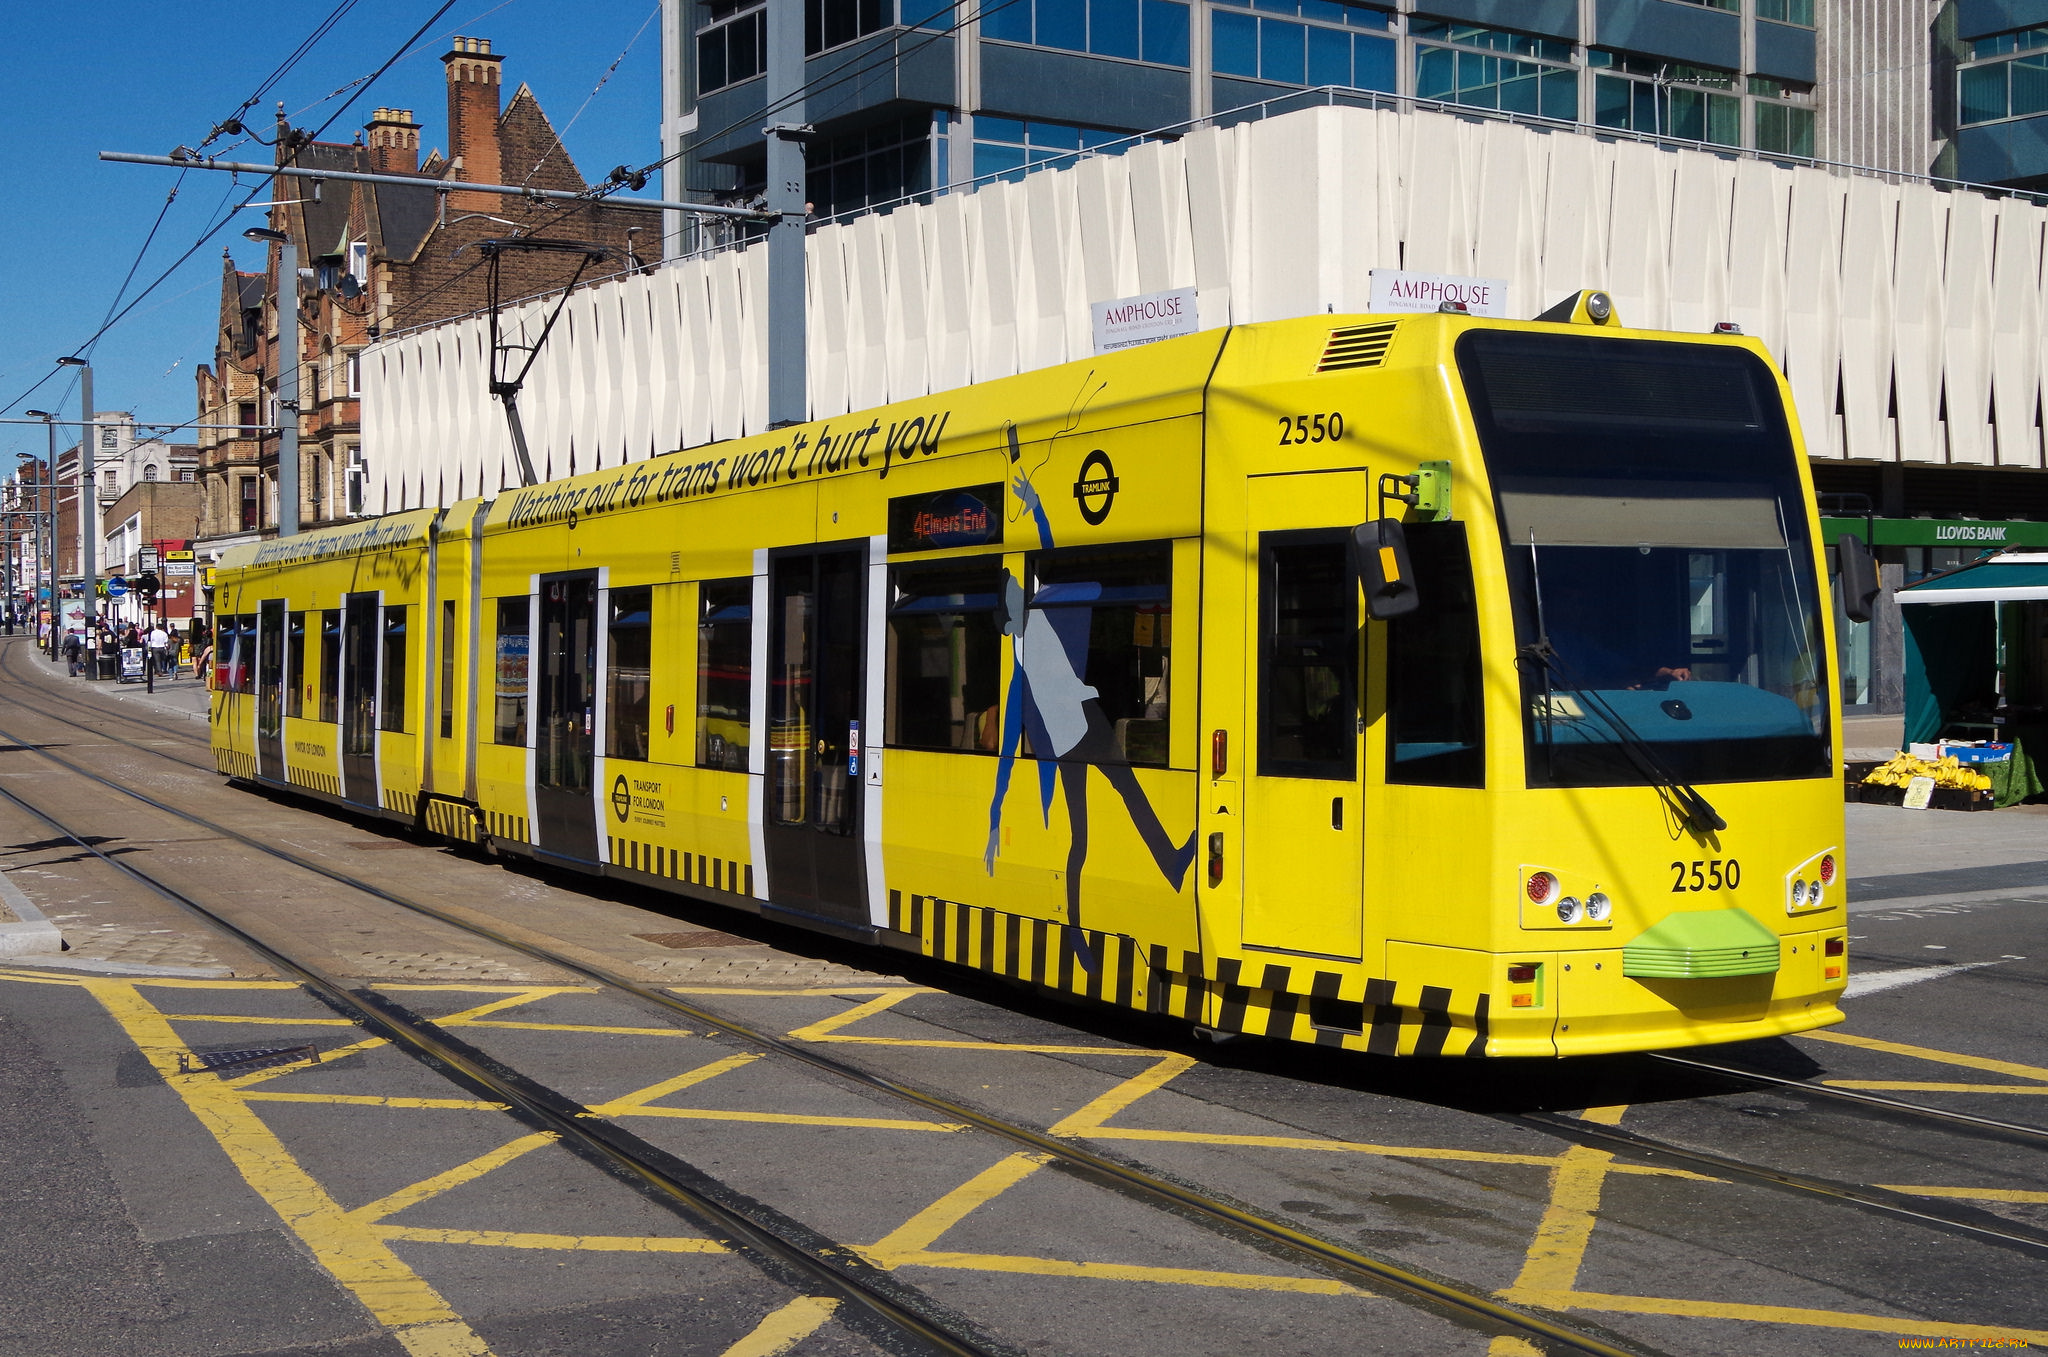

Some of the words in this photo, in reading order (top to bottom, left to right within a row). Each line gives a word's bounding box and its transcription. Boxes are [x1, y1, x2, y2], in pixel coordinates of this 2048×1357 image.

[1389, 279, 1490, 305] AMPHOUSE
[1105, 296, 1183, 326] AMPHOUSE
[1278, 411, 1344, 446] 2550
[508, 482, 588, 530] Watching
[584, 473, 625, 516] out
[621, 464, 660, 509] for
[656, 457, 727, 503] trams
[728, 430, 809, 490] won't
[807, 424, 881, 477] hurt
[879, 410, 951, 480] you
[1081, 481, 1110, 494] TRAMLINK
[963, 506, 987, 531] End
[1936, 526, 1976, 540] LLOYDS
[1976, 527, 2007, 540] BANK
[633, 779, 662, 794] TRANSPORT
[632, 795, 643, 808] FOR
[643, 797, 665, 811] LONDON
[1670, 858, 1741, 893] 2550
